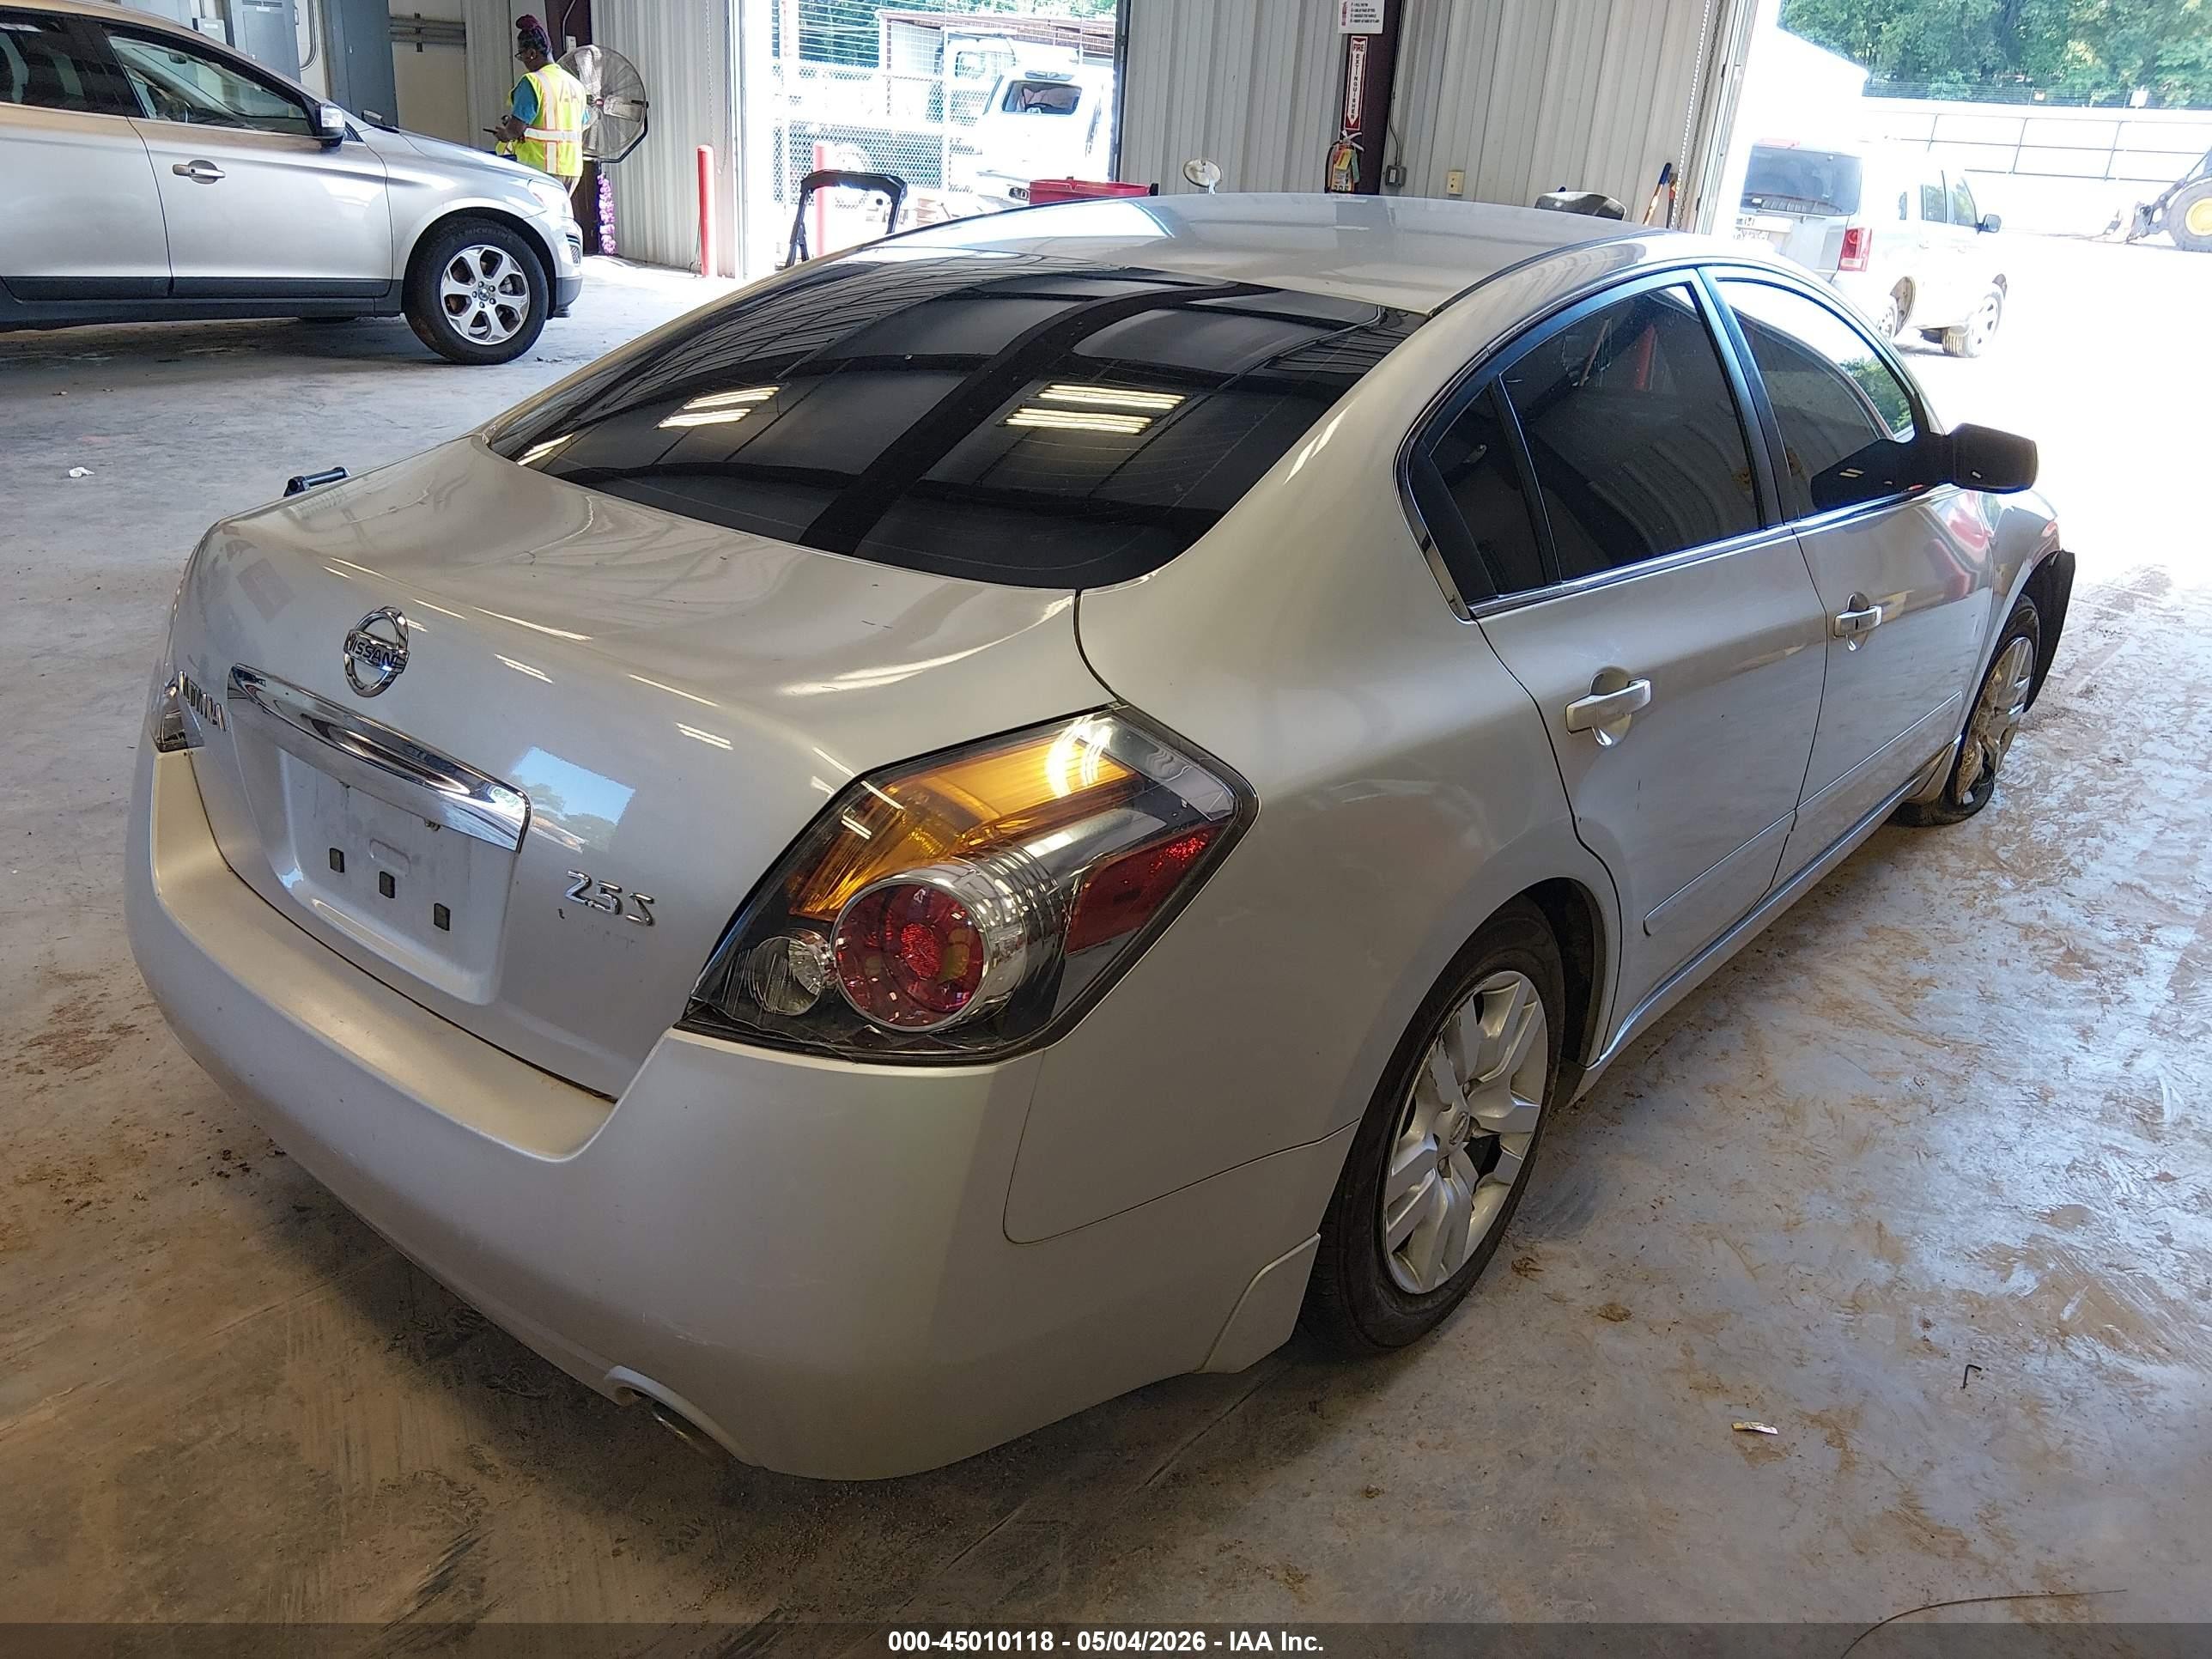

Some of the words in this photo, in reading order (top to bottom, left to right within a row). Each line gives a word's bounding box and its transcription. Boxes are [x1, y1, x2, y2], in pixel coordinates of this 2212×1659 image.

[1352, 43, 1364, 52] FIRE
[1351, 53, 1360, 119] EXTINGUISHER
[347, 633, 399, 669] NISSAN
[625, 892, 655, 927] S
